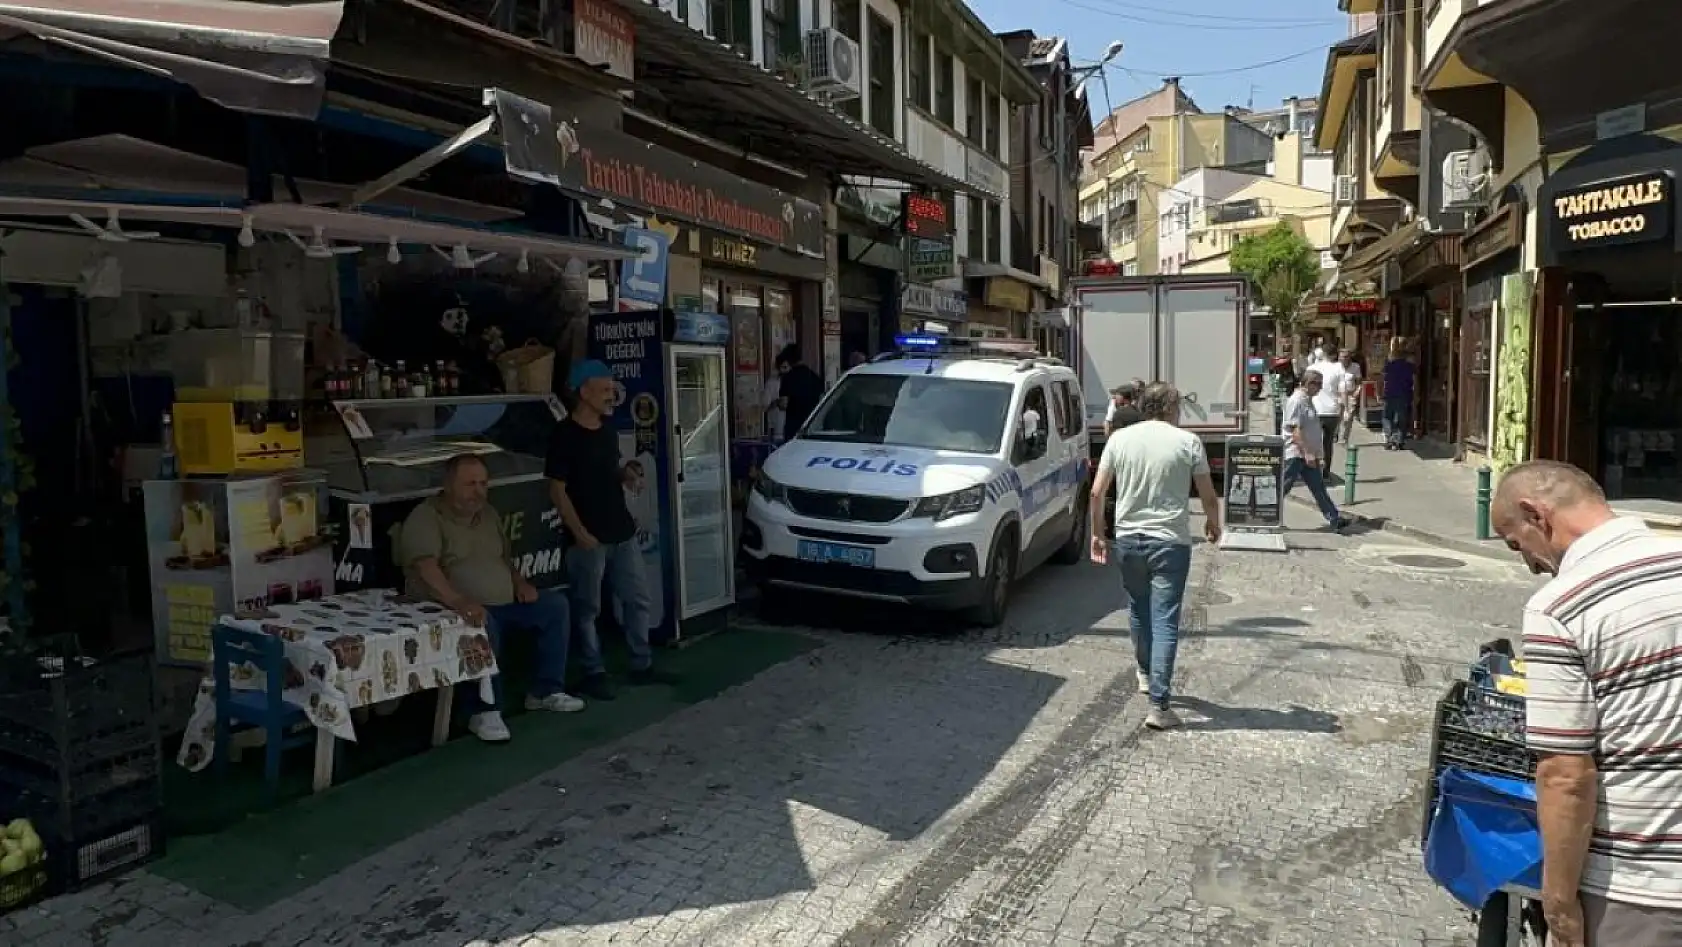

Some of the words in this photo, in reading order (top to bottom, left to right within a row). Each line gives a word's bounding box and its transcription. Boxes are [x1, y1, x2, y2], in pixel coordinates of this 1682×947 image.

[578, 19, 634, 72] OTOPARK
[582, 148, 633, 199] Tarihi
[634, 165, 703, 219] Tahtakale
[1555, 178, 1663, 219] TAHTAKALE
[1568, 214, 1646, 241] TOBACCO
[806, 455, 919, 477] POLİS
